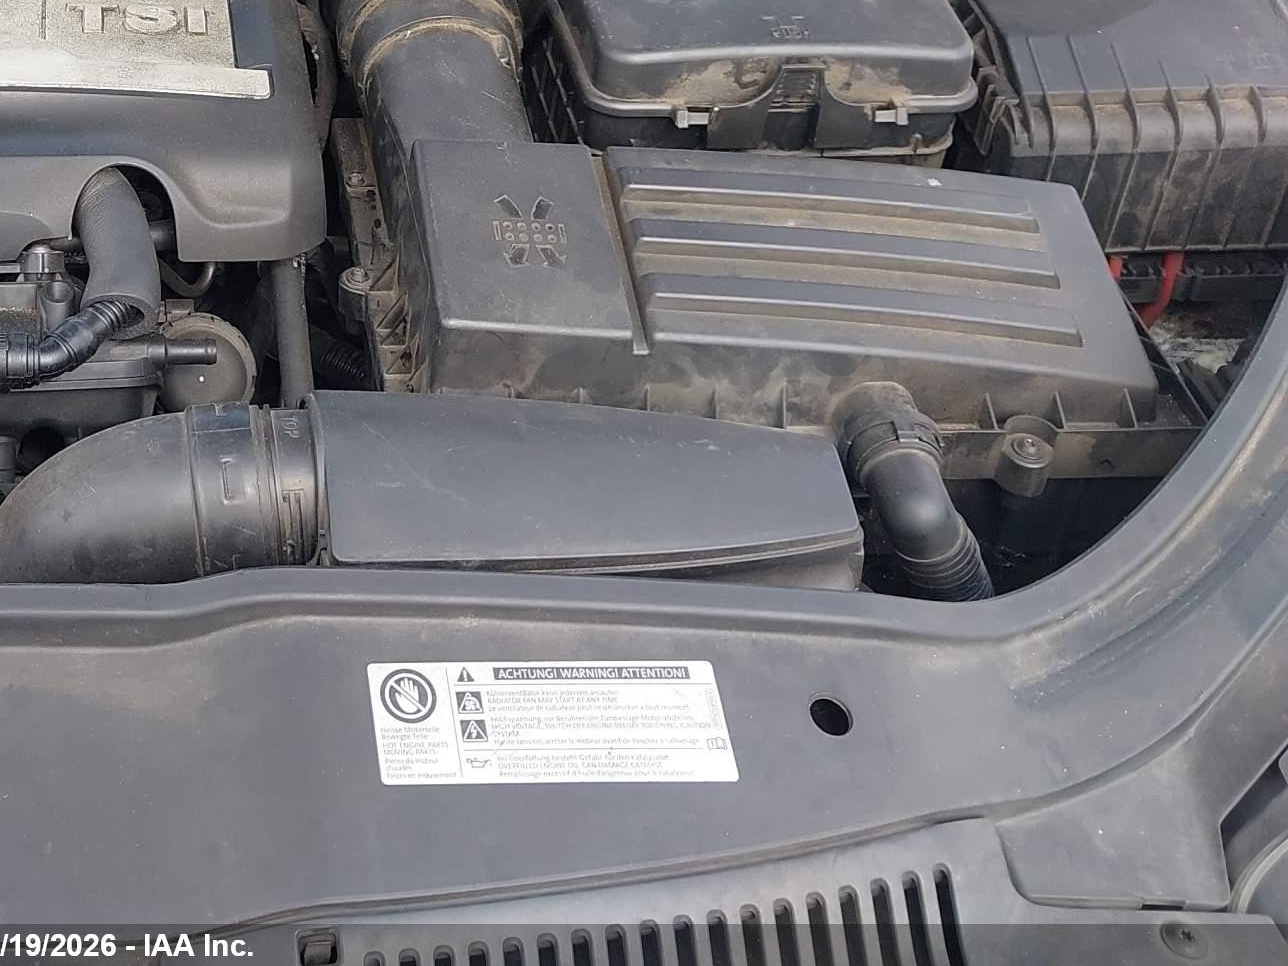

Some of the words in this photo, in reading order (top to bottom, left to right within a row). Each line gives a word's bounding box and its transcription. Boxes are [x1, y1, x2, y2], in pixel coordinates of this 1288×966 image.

[65, 2, 209, 35] TSI
[498, 668, 558, 679] ACHTUNG!
[560, 668, 619, 679] WARNING!
[621, 668, 686, 679] ATTENTION!
